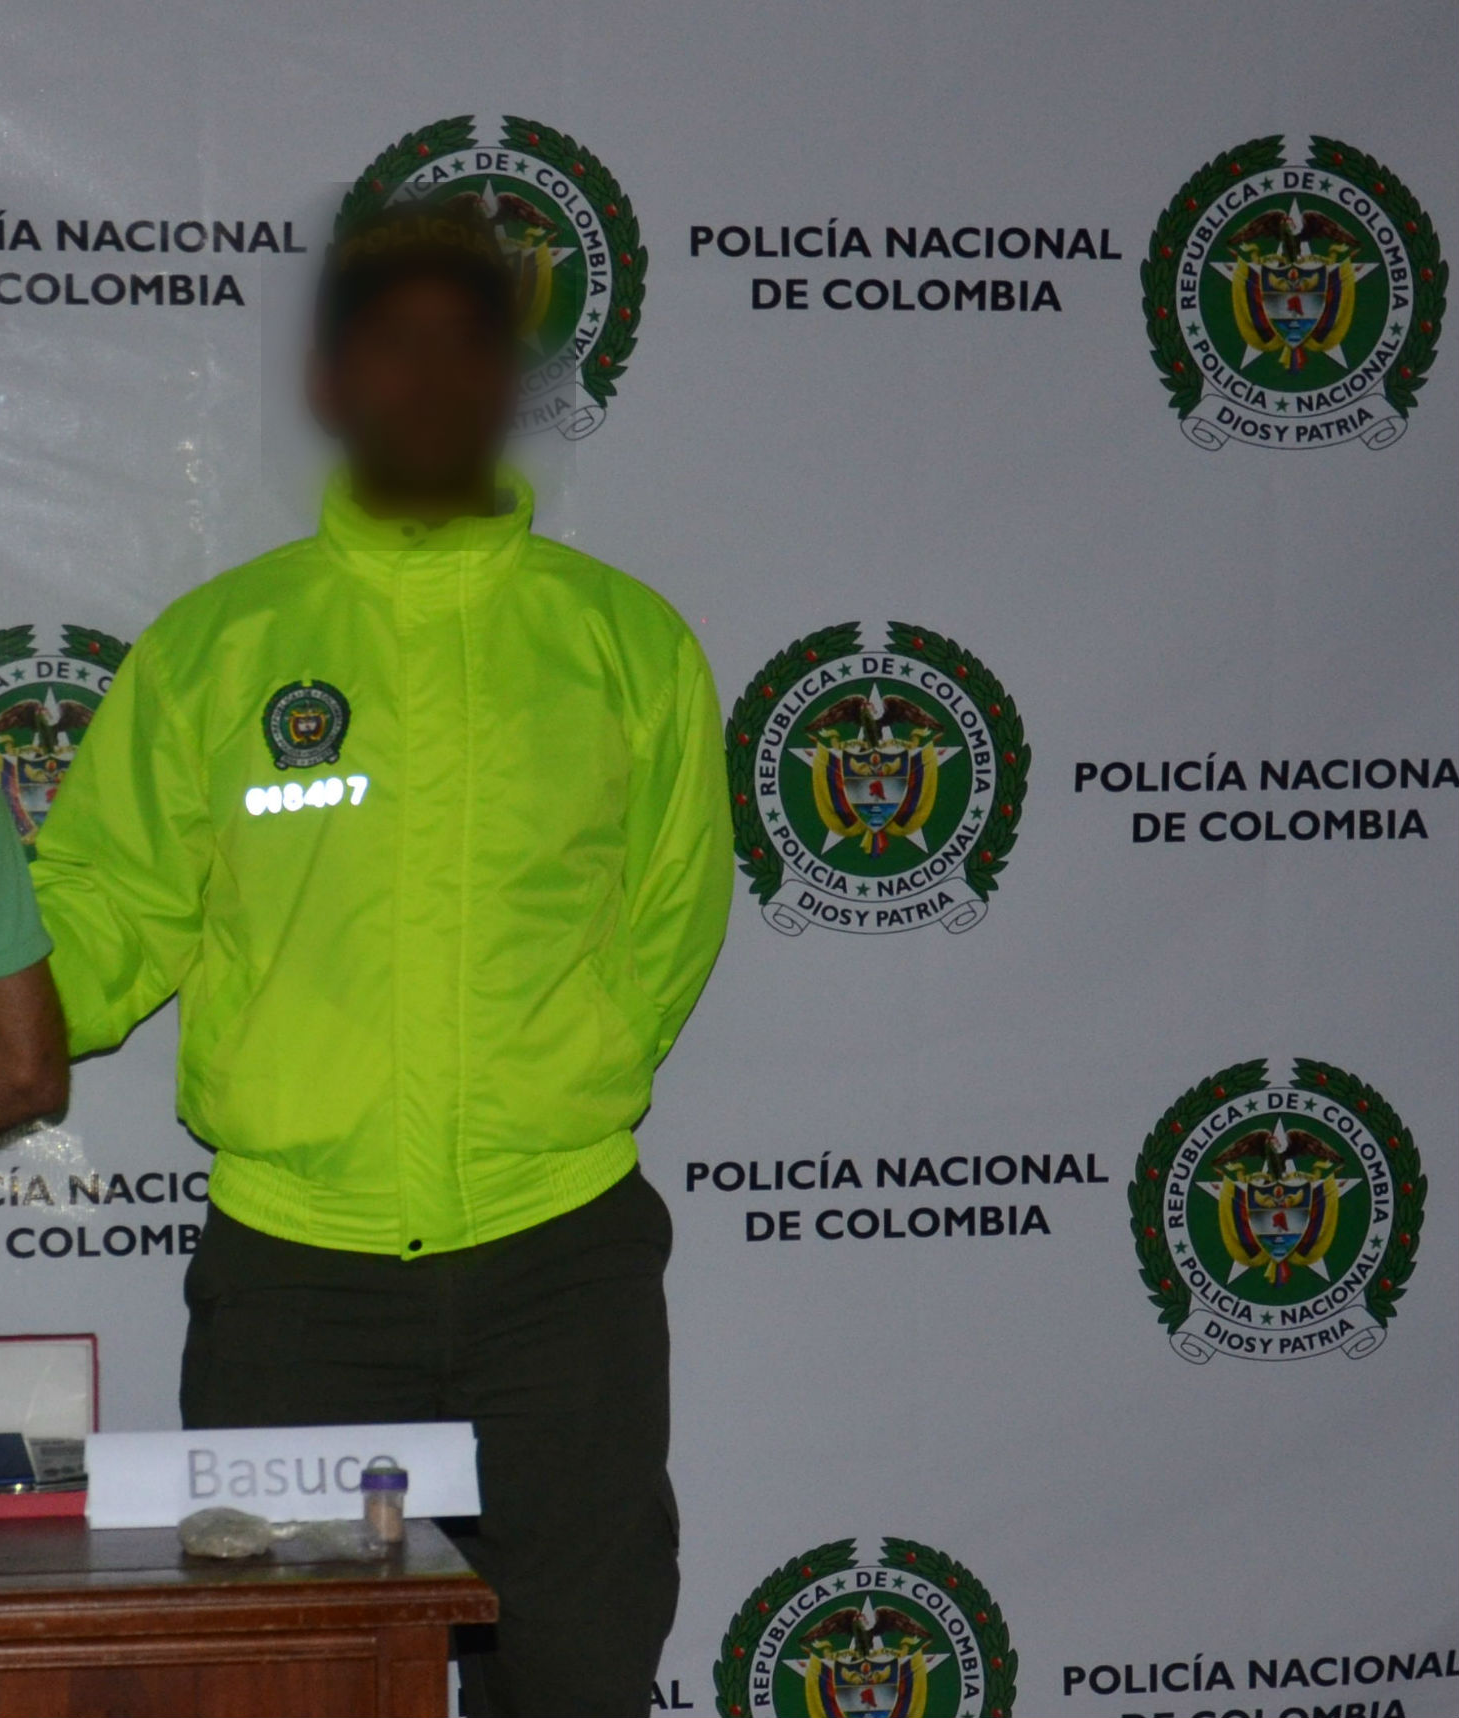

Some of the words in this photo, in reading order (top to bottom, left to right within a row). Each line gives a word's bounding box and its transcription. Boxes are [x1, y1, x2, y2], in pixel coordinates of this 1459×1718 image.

[57, 220, 307, 253] NACIONAL
[476, 153, 508, 172] DE
[534, 169, 608, 296] COLOMBIA
[691, 218, 871, 258] POLICÍA
[886, 227, 1122, 259] NACIONAL
[1284, 172, 1315, 190] DE
[1339, 188, 1409, 310] COLOMBIA
[752, 279, 808, 309] DE
[823, 279, 1062, 311] COLOMBIA
[1297, 340, 1400, 413] NACIONAL
[1296, 408, 1374, 442] PATRIA
[36, 661, 69, 679] DE
[864, 657, 896, 675] DE
[920, 672, 991, 794] COLOMBIA
[1075, 752, 1247, 792] POLICÍA
[1261, 758, 1459, 790] NACIONA
[1133, 812, 1186, 843] DE
[1200, 809, 1428, 842] COLOMBIA
[877, 823, 982, 897] NACIONAL
[877, 892, 956, 927] PATRIA
[687, 1151, 862, 1192] POLICÍA
[877, 1153, 1109, 1188] NACIONAL
[1268, 1093, 1297, 1110] DE
[1321, 1107, 1389, 1224] COLOMBIA
[69, 1172, 210, 1204] NACIO
[6, 1224, 201, 1259] COLOMB
[746, 1211, 801, 1242] DE
[815, 1205, 1051, 1240] COLOMBIA
[1281, 1252, 1380, 1325] NACIONAL
[1280, 1319, 1355, 1354] PATRIA
[856, 1571, 887, 1587] DE
[911, 1583, 980, 1697] COLOMBIA
[1064, 1653, 1235, 1696] POLICÍA
